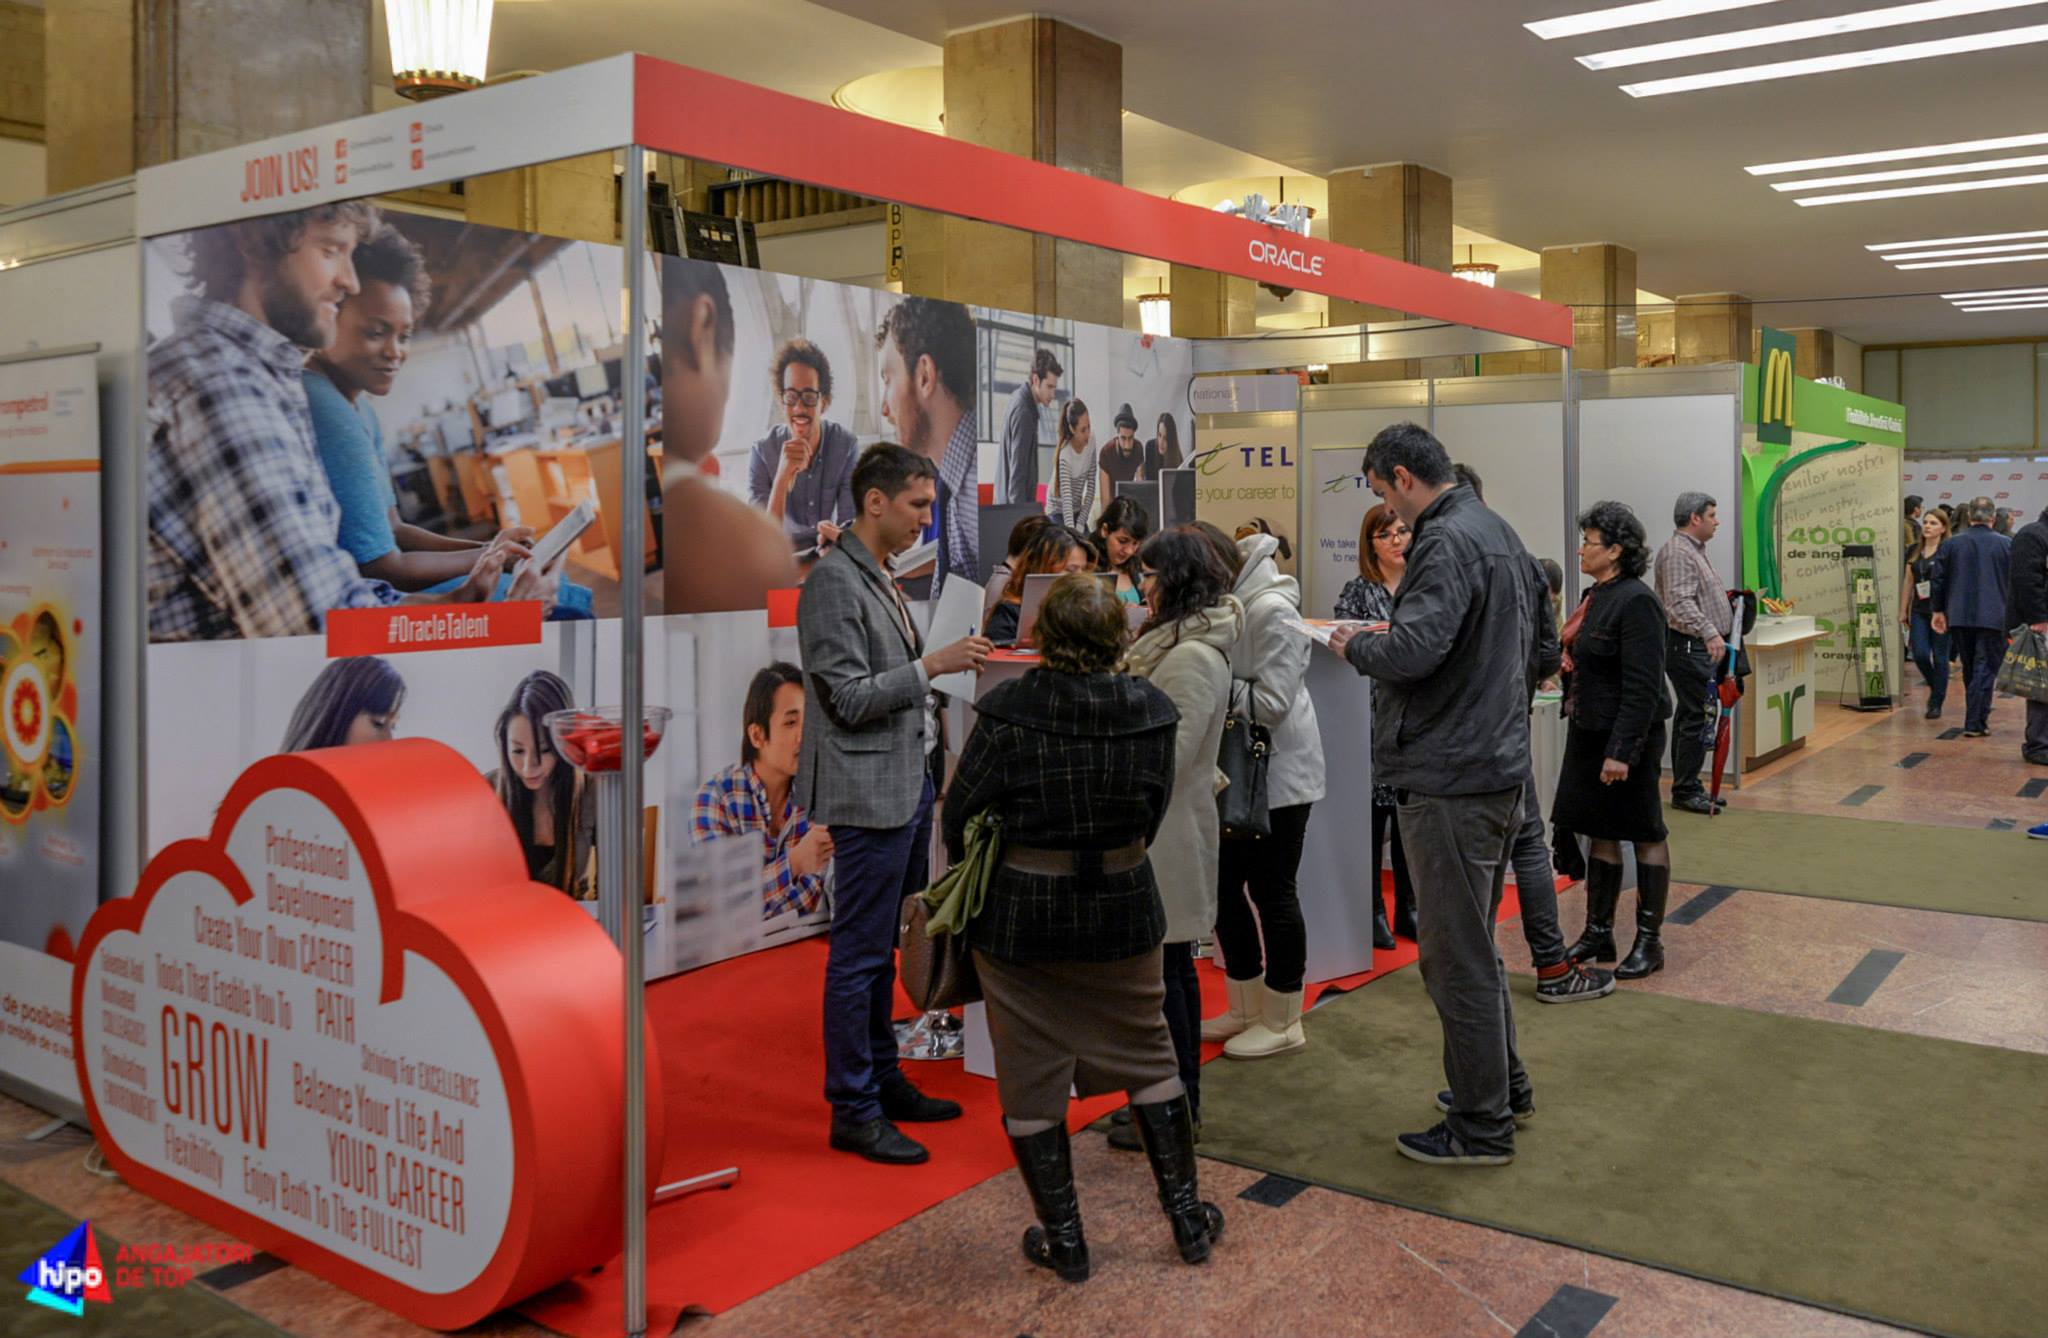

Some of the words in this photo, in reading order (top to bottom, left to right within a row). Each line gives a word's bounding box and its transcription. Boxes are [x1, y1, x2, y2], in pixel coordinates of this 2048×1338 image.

[241, 153, 284, 203] JOIN
[287, 146, 319, 194] US!
[1249, 240, 1323, 277] ORACLE
[1207, 486, 1234, 503] your
[1237, 486, 1279, 501] career
[1281, 483, 1296, 500] to
[1320, 538, 1335, 549] We
[1337, 538, 1357, 549] take
[1333, 553, 1343, 562] to
[1786, 527, 1877, 546] 4000
[1787, 549, 1807, 559] de
[387, 612, 489, 644] #OracleTalent
[265, 824, 349, 882] Professional
[266, 872, 354, 932] Development
[194, 904, 233, 953] Create
[235, 916, 262, 961] Your
[266, 924, 297, 971] Own
[301, 933, 354, 988] CAREER
[155, 952, 184, 996] Tools
[186, 962, 210, 1004] That
[213, 970, 251, 1017] Enable
[253, 984, 276, 1026] You
[277, 990, 292, 1031] To
[315, 988, 355, 1044] PATH
[161, 1004, 269, 1151] GROW
[418, 1061, 480, 1109] EXCELLENCE
[293, 1061, 353, 1125] Balance
[355, 1084, 389, 1139] Your
[394, 1097, 427, 1152] Life
[431, 1110, 465, 1166] And
[164, 1122, 225, 1190] Flexibility
[327, 1127, 379, 1201] YOUR
[385, 1151, 466, 1236] CAREER
[244, 1154, 277, 1211] Enjoy
[280, 1170, 312, 1222] Both
[314, 1184, 330, 1230] To
[331, 1192, 358, 1243] The
[360, 1205, 423, 1271] FULLEST
